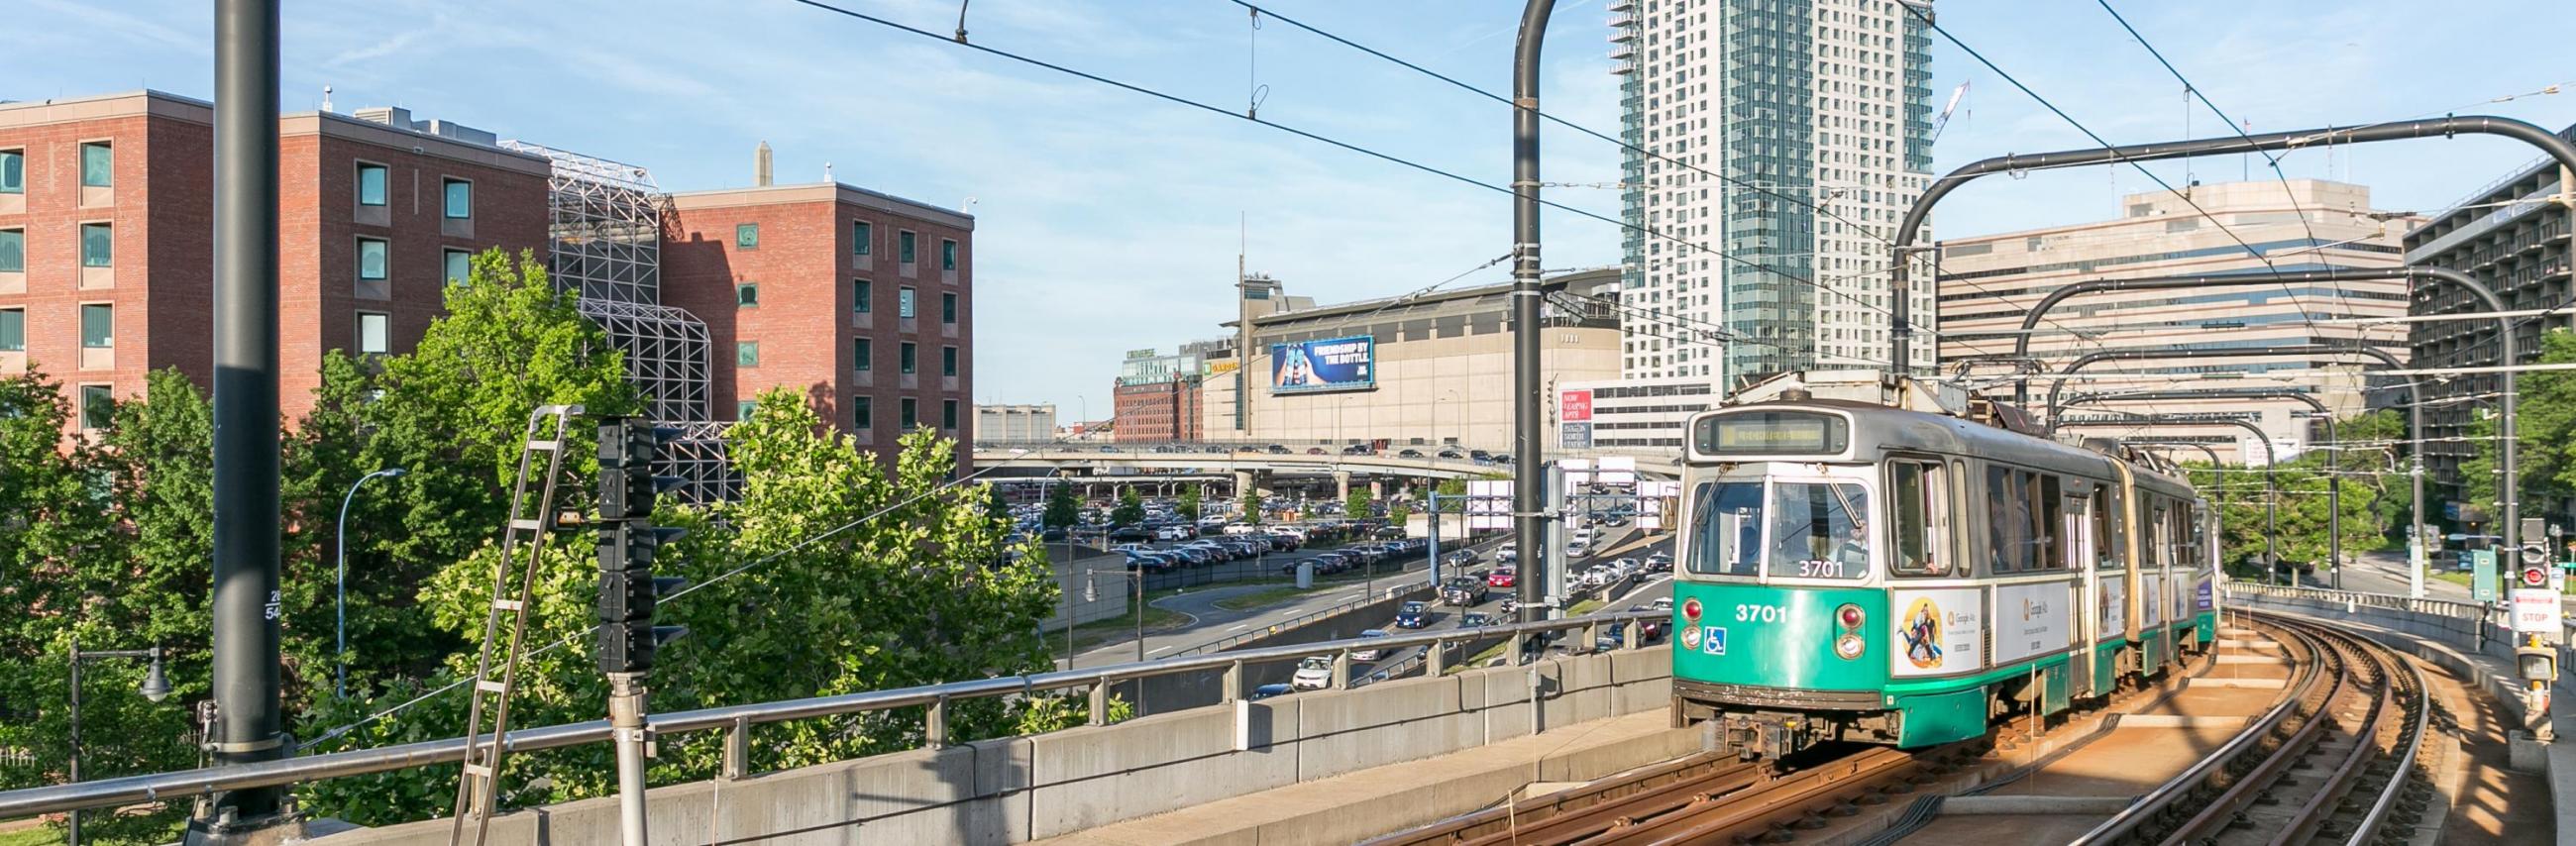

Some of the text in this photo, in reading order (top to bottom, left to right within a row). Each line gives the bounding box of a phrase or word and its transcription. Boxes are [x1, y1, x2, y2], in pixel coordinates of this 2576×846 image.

[1314, 341, 1368, 357] FRIENDSHIP BY
[1325, 355, 1339, 366] THE
[1799, 560, 1843, 578] 3701
[1736, 603, 1786, 623] 3701
[2522, 612, 2548, 622] STOP
